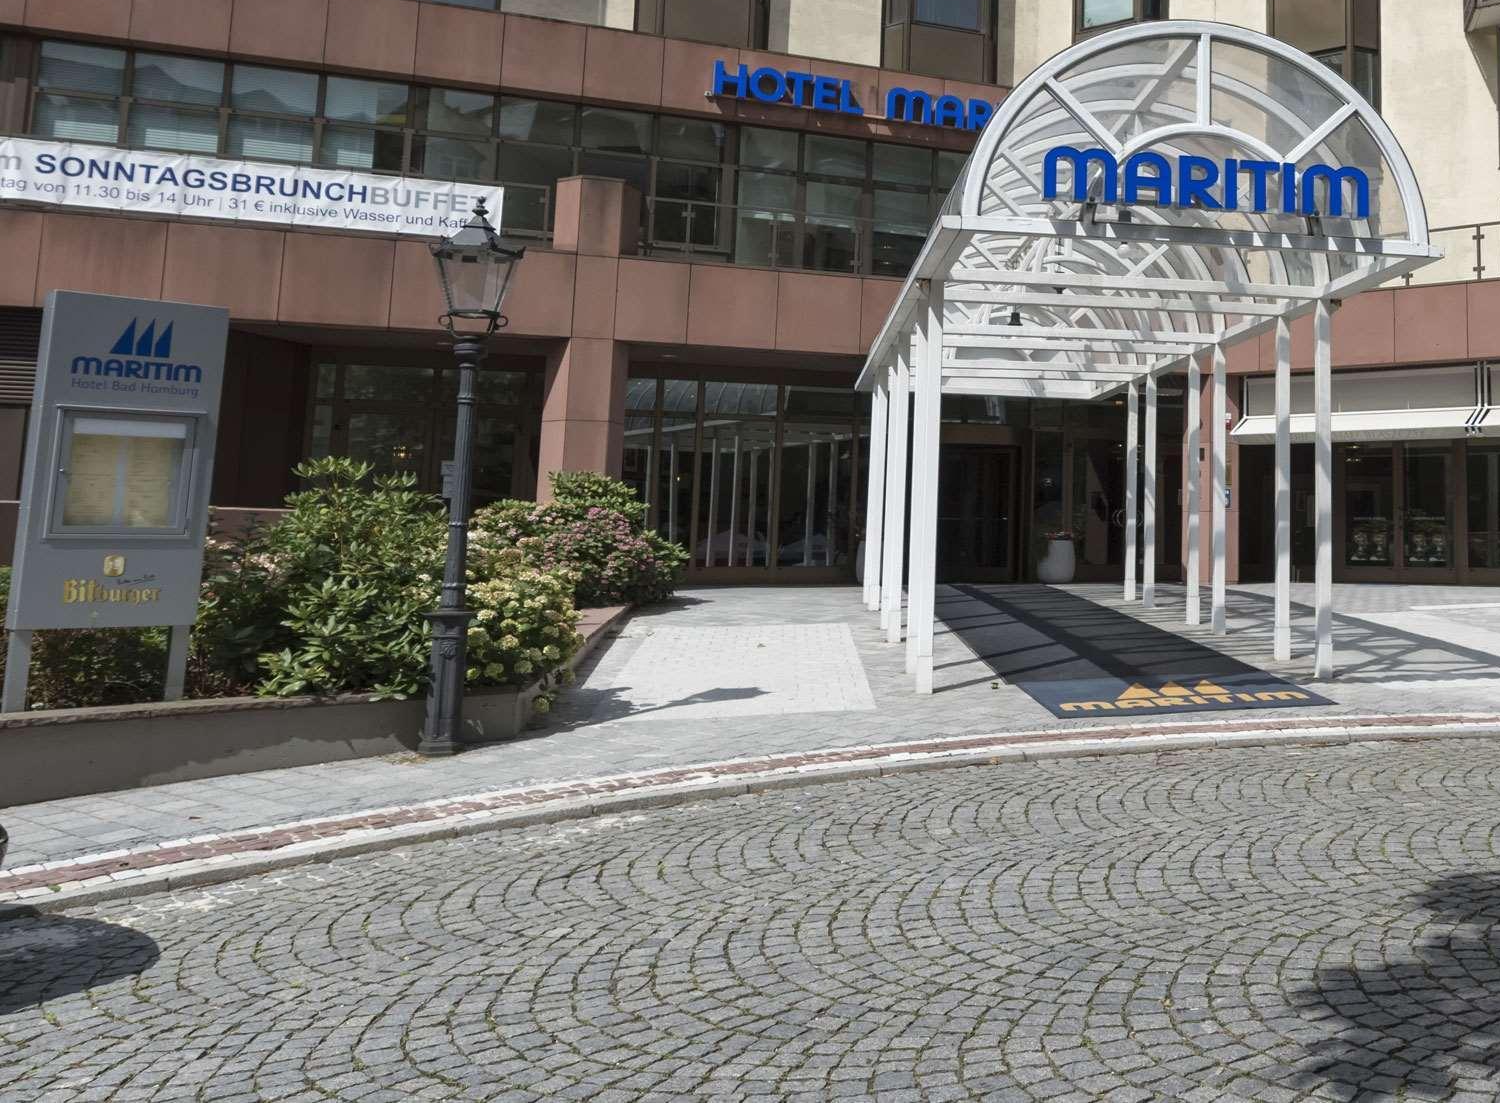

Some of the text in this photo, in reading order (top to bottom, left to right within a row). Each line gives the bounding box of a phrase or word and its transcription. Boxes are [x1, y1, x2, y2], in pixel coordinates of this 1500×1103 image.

[713, 59, 994, 132] HOTEL MAR
[33, 182, 66, 194] von
[74, 184, 120, 199] 11.30
[126, 188, 151, 202] bis
[159, 191, 177, 204] 14
[183, 193, 214, 207] Uhr
[228, 198, 248, 210] 31
[254, 200, 265, 212] €
[269, 200, 338, 218] inklusive
[343, 207, 402, 223] Wasser
[406, 214, 433, 226] und
[438, 216, 468, 228] Kaff
[35, 154, 481, 213] SONNTAGSBRUNCHBUFFE
[1043, 146, 1369, 218] MARITIM
[71, 356, 203, 383] MARITIM
[71, 378, 107, 390] Hotel
[1059, 690, 1312, 711] MARITIM
